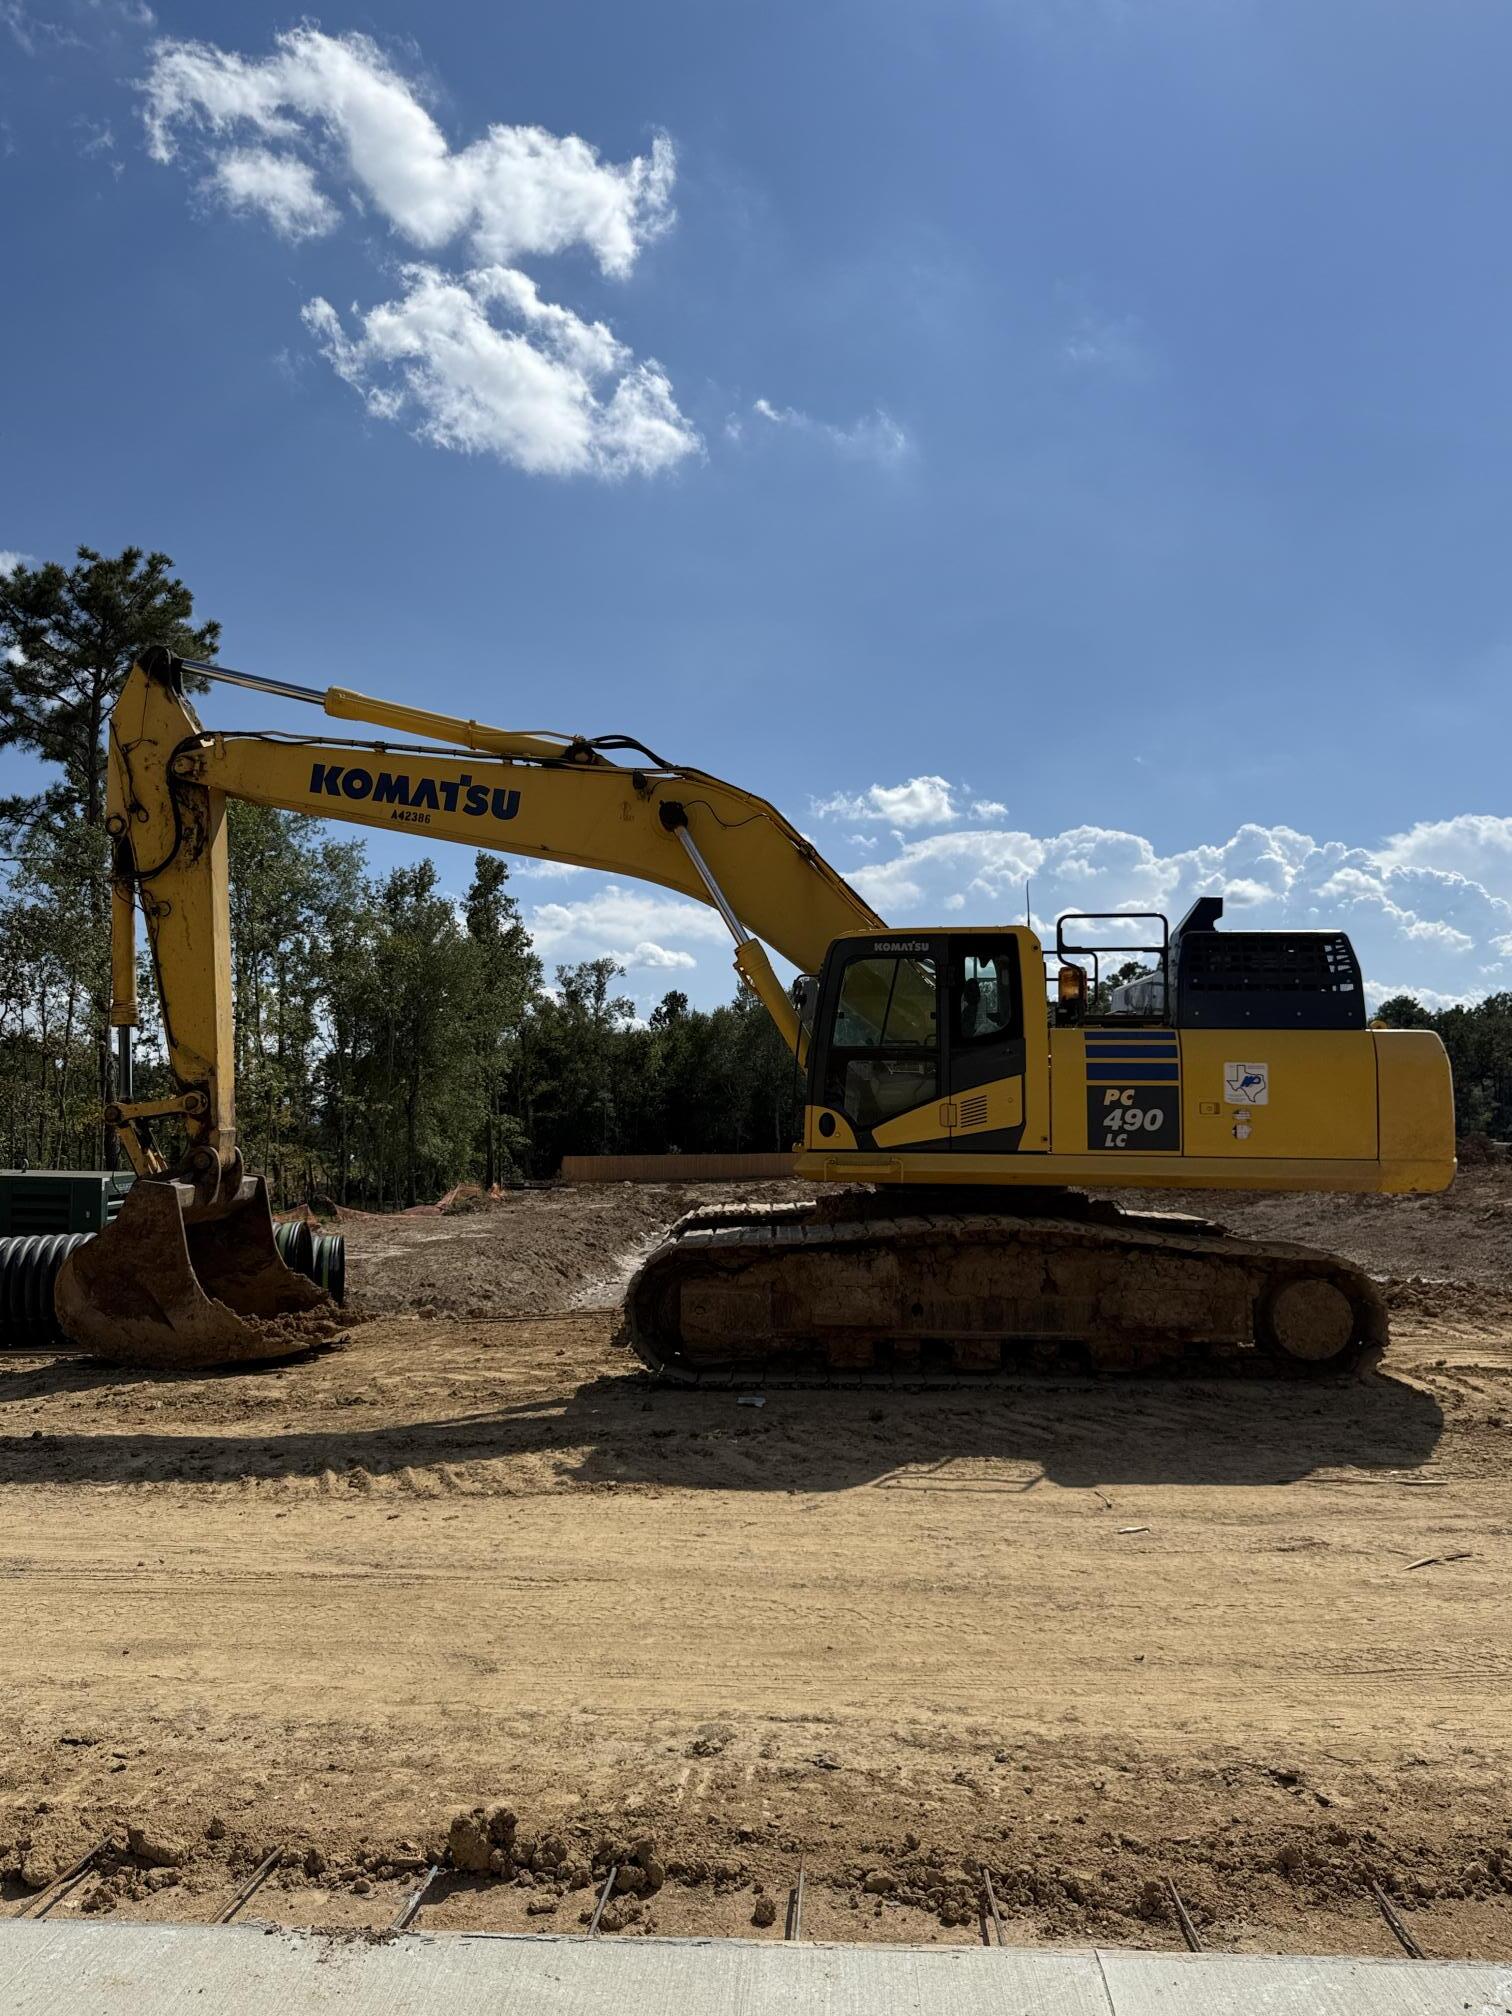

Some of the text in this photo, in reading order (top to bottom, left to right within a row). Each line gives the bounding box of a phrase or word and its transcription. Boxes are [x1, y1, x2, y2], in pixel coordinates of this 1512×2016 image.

[309, 763, 521, 820] KOMATSU
[390, 809, 431, 824] A42386
[874, 940, 930, 951] KOMATSU
[1103, 1089, 1135, 1105] PC
[1103, 1108, 1164, 1131] 490
[1104, 1133, 1127, 1147] LC
